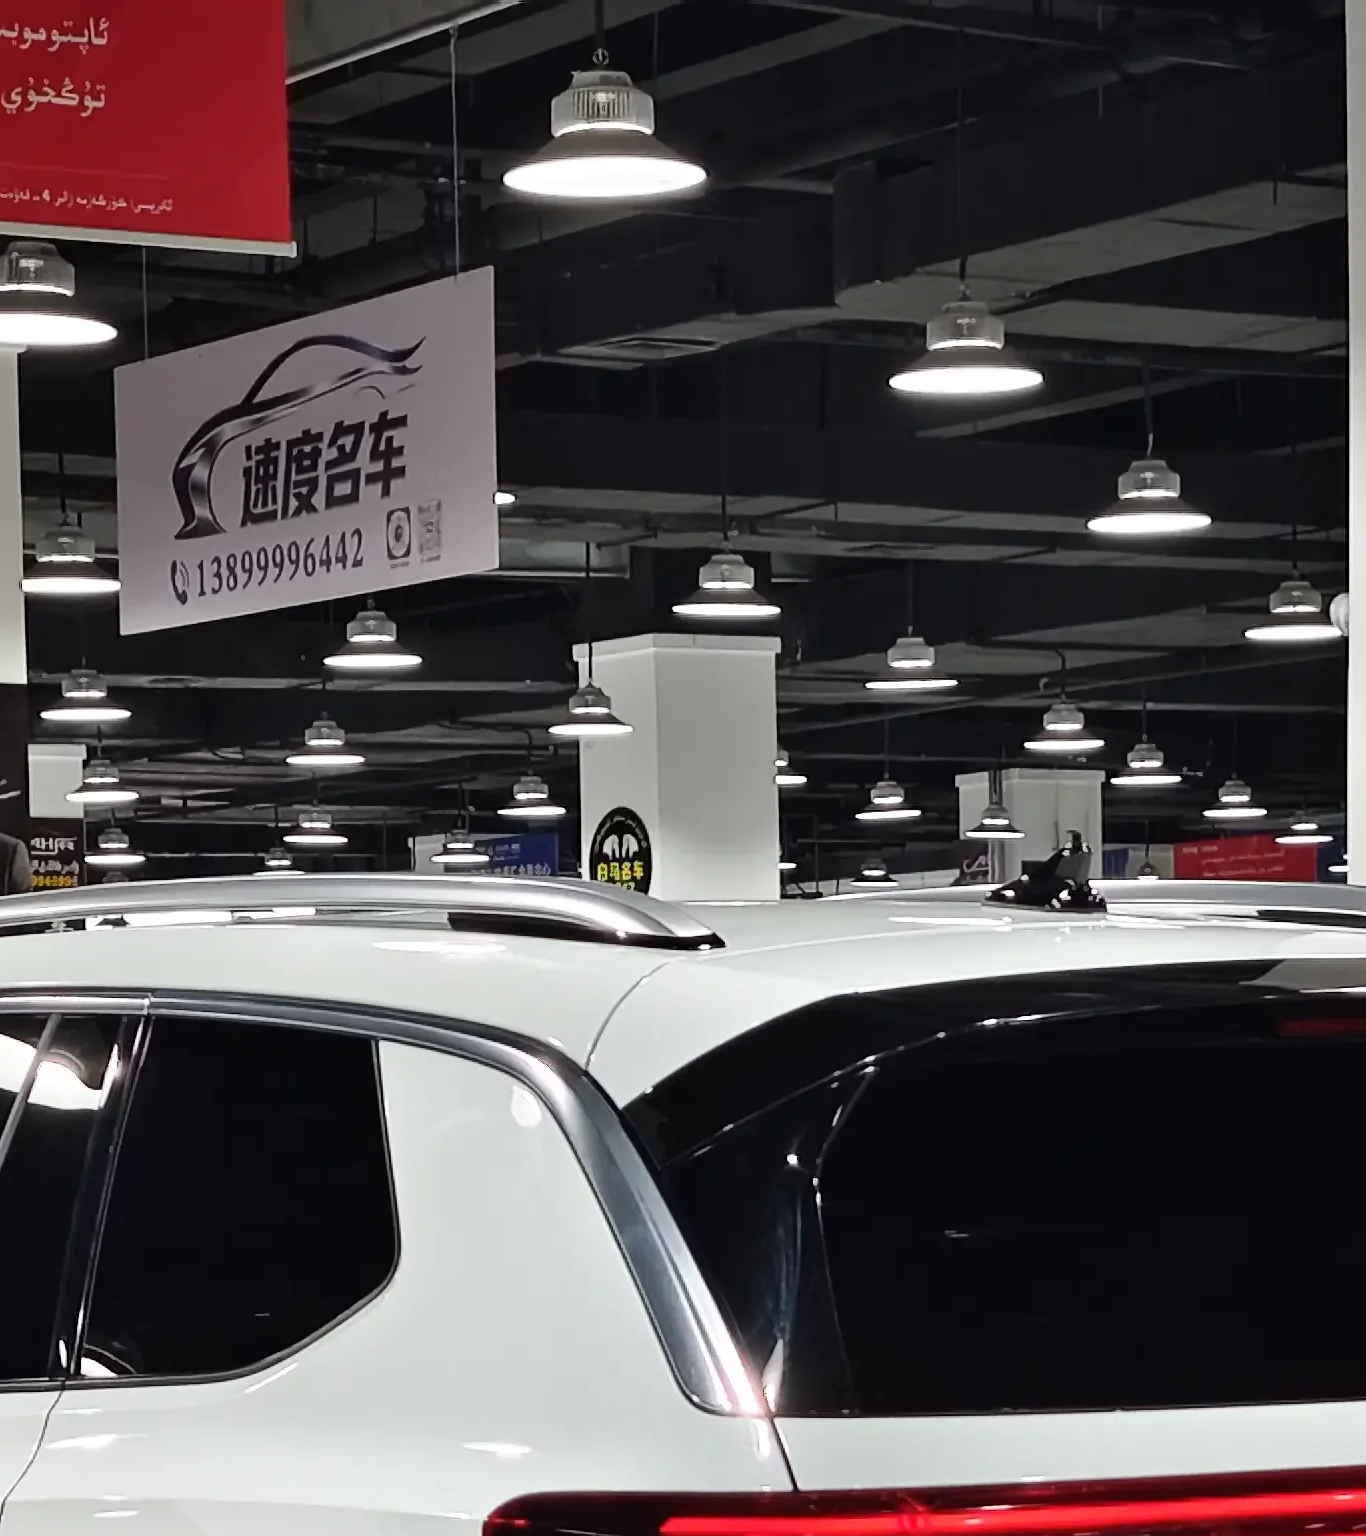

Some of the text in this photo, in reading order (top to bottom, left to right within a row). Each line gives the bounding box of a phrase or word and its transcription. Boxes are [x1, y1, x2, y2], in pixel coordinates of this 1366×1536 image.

[240, 409, 408, 528] 速度名车
[196, 527, 364, 597] 13899996442
